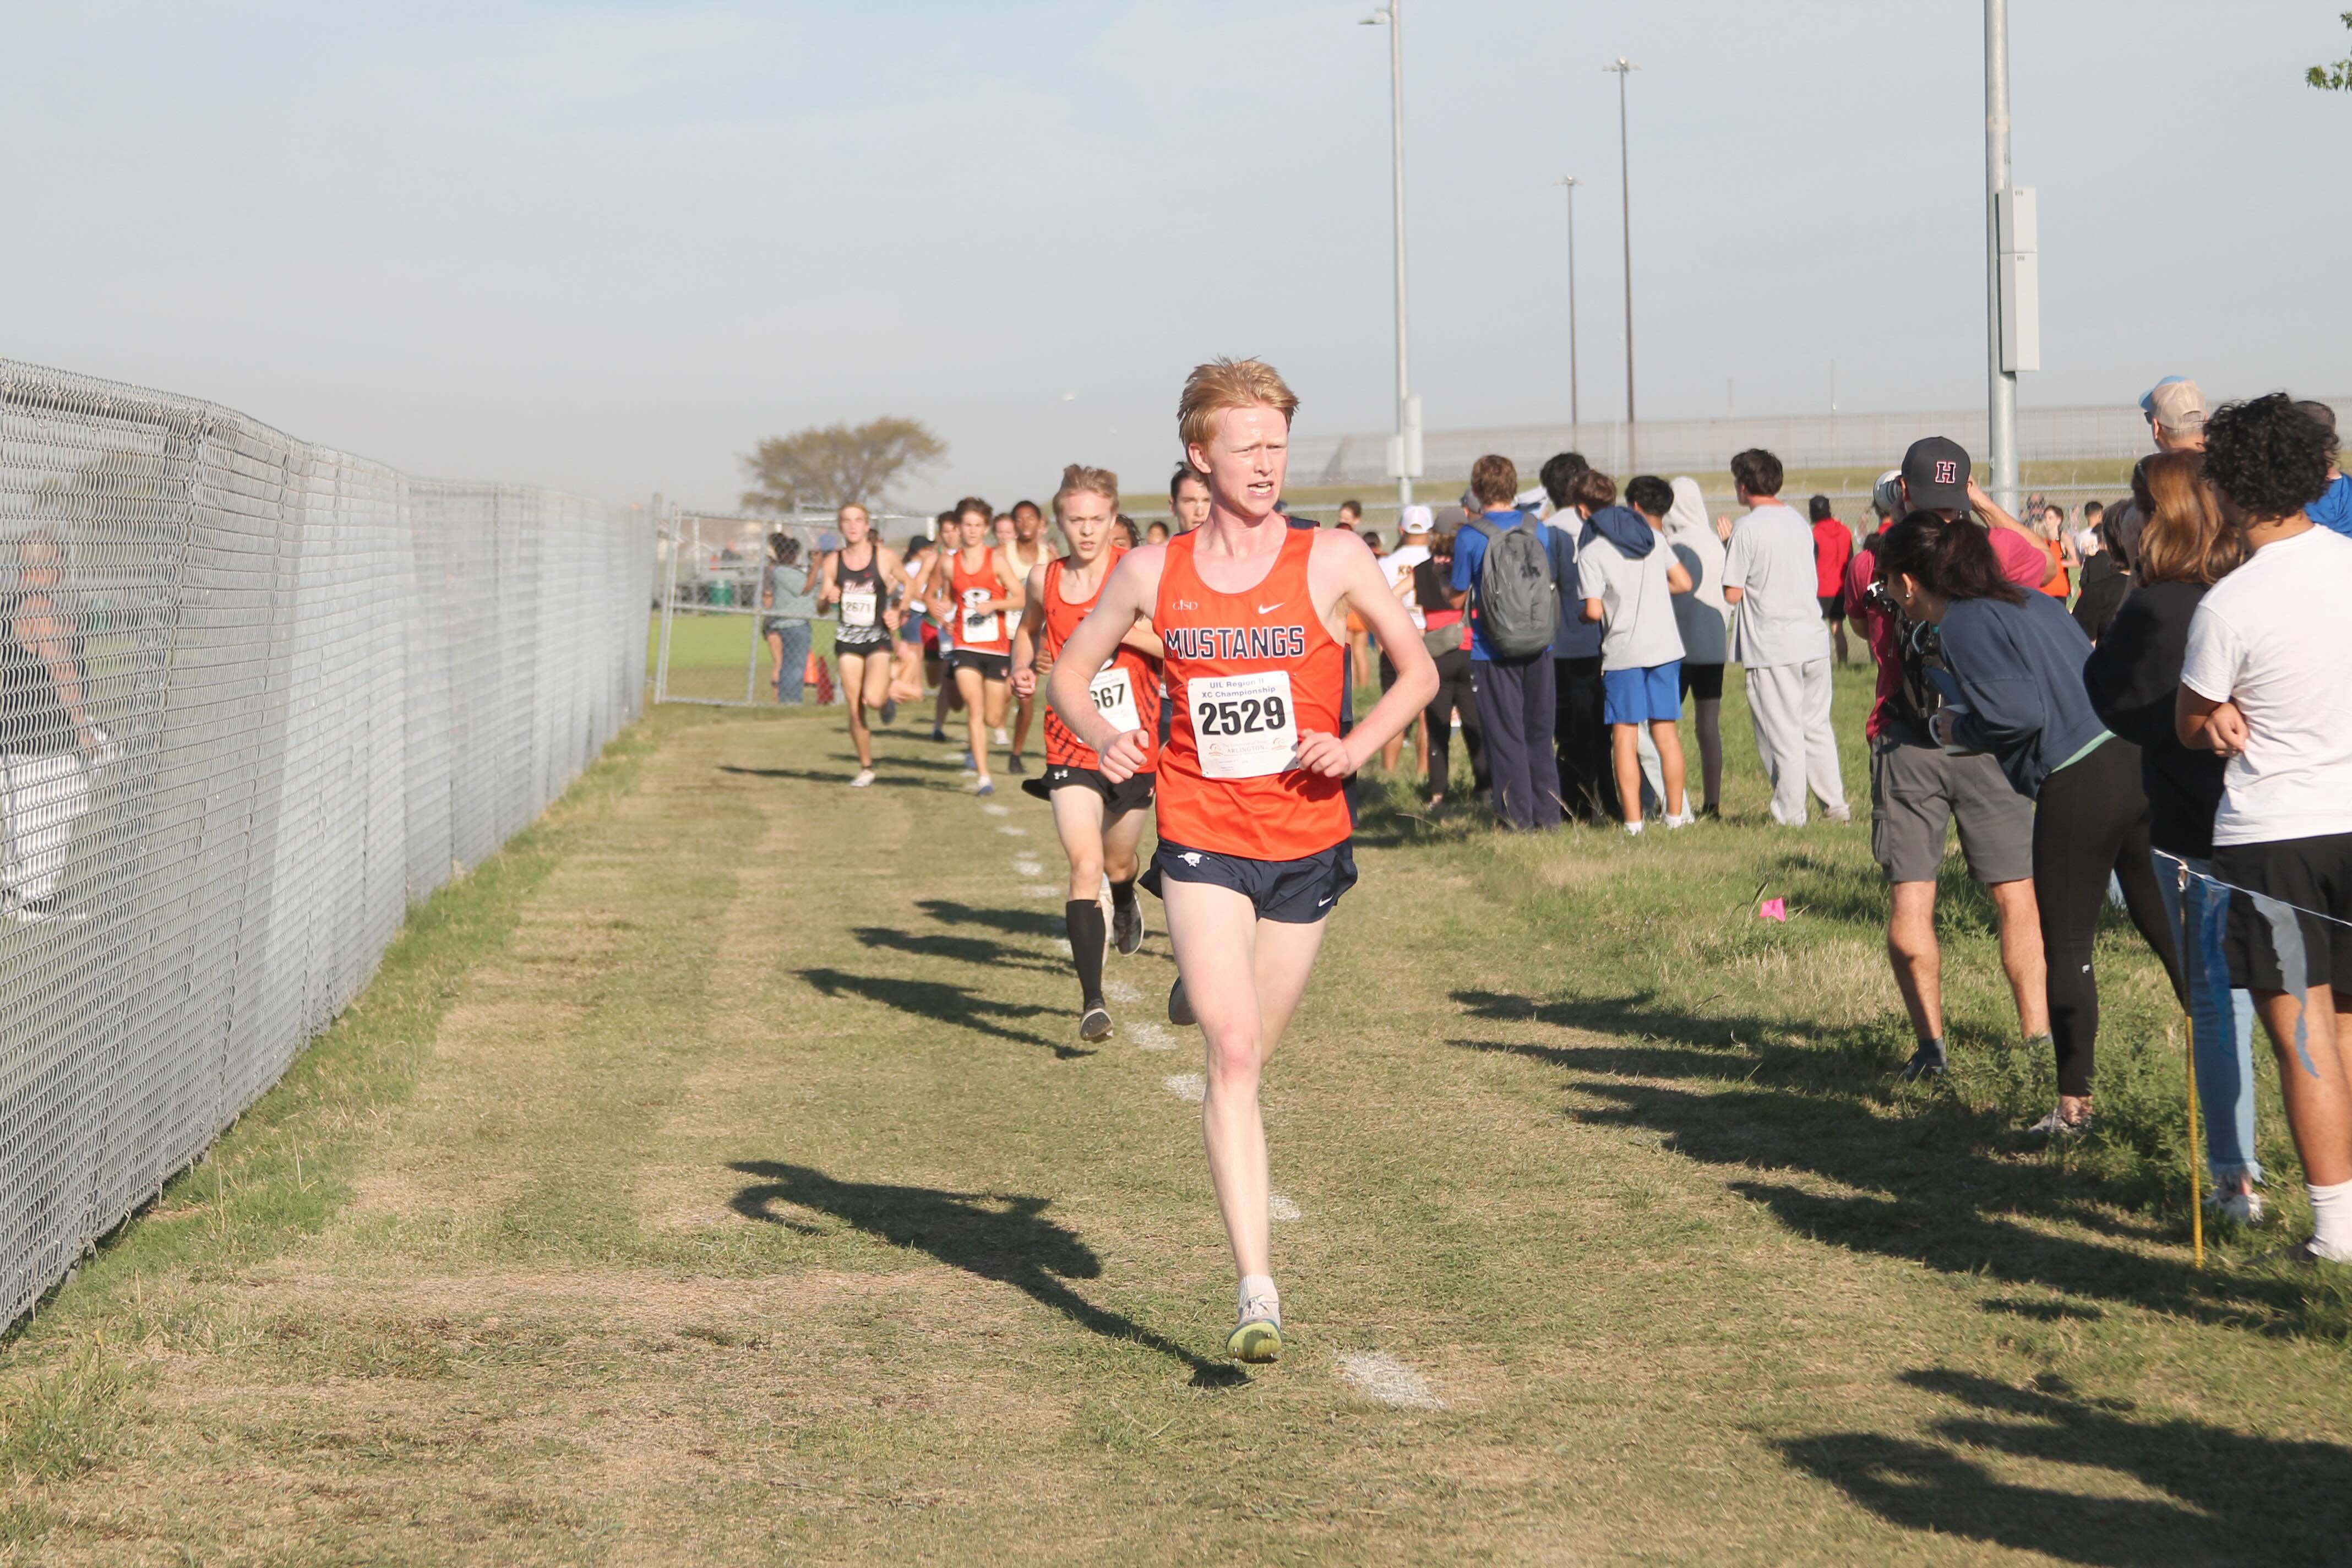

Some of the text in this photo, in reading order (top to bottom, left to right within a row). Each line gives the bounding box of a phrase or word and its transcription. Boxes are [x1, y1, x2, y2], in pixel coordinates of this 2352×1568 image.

[1934, 460, 1956, 484] H
[1165, 625, 1304, 660] MUSTANGS
[1215, 687, 1276, 697] Championship
[1198, 696, 1286, 736] 2529
[1227, 745, 1265, 754] ARLINGTON
